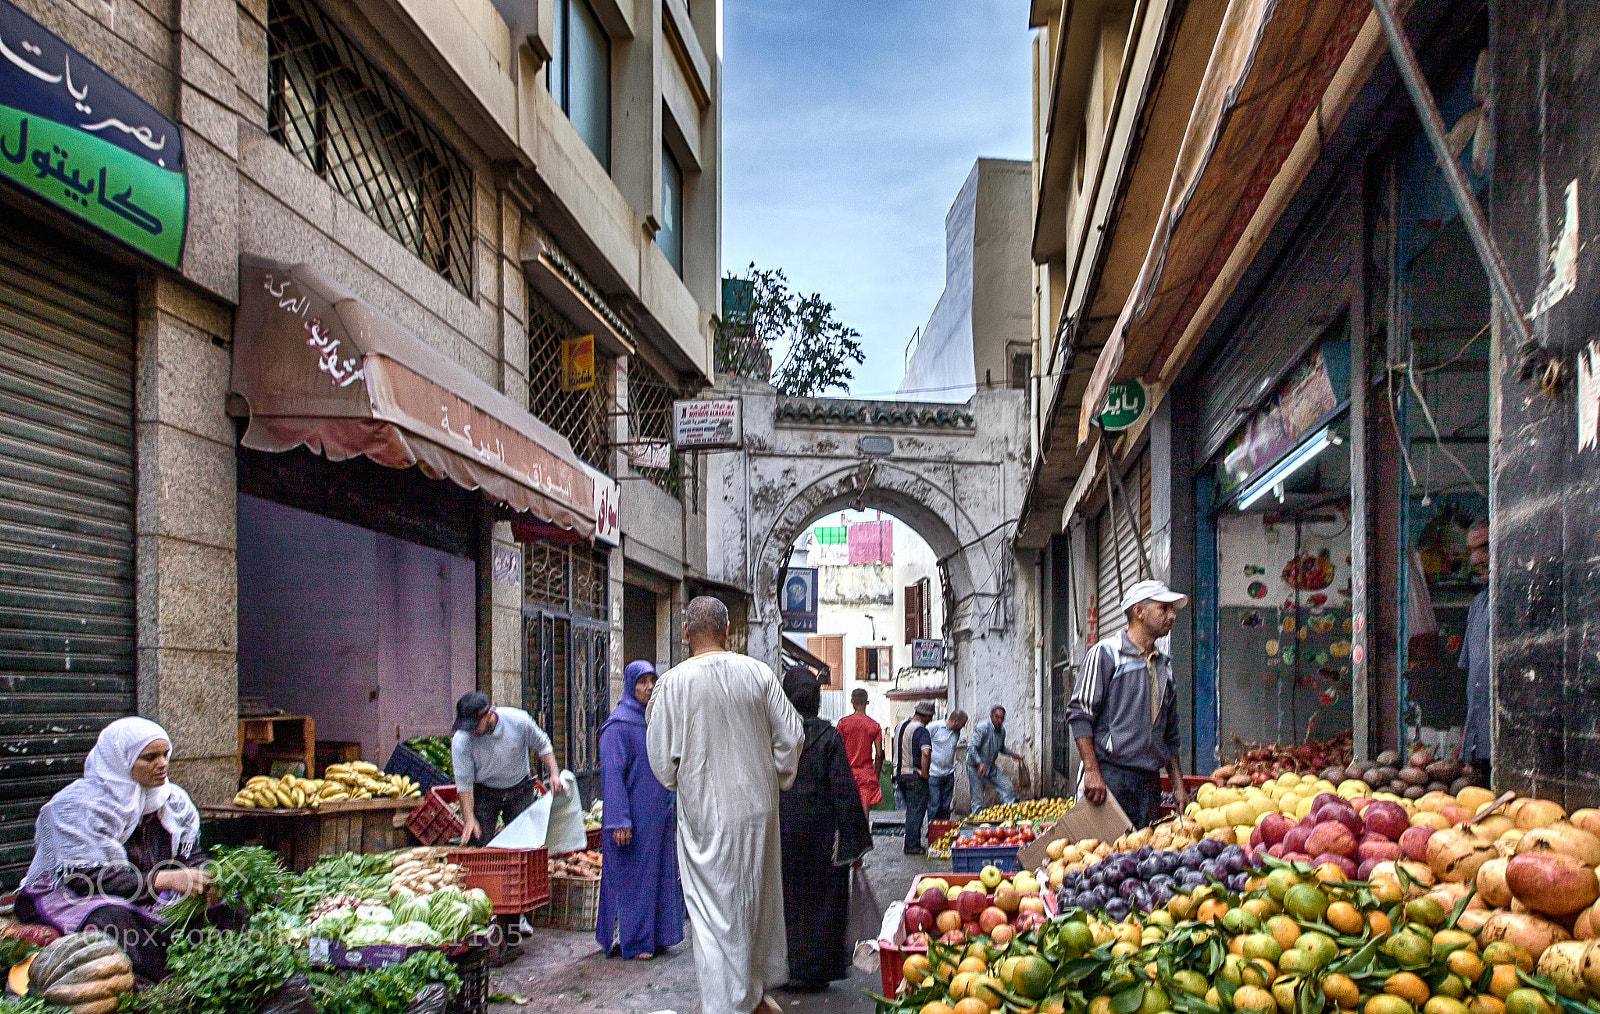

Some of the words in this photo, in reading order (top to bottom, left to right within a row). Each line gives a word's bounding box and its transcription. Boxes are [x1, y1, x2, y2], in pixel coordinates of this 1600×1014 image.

[1, 118, 163, 236] كابيتول
[264, 273, 311, 318] البركة
[441, 404, 505, 463] البركة
